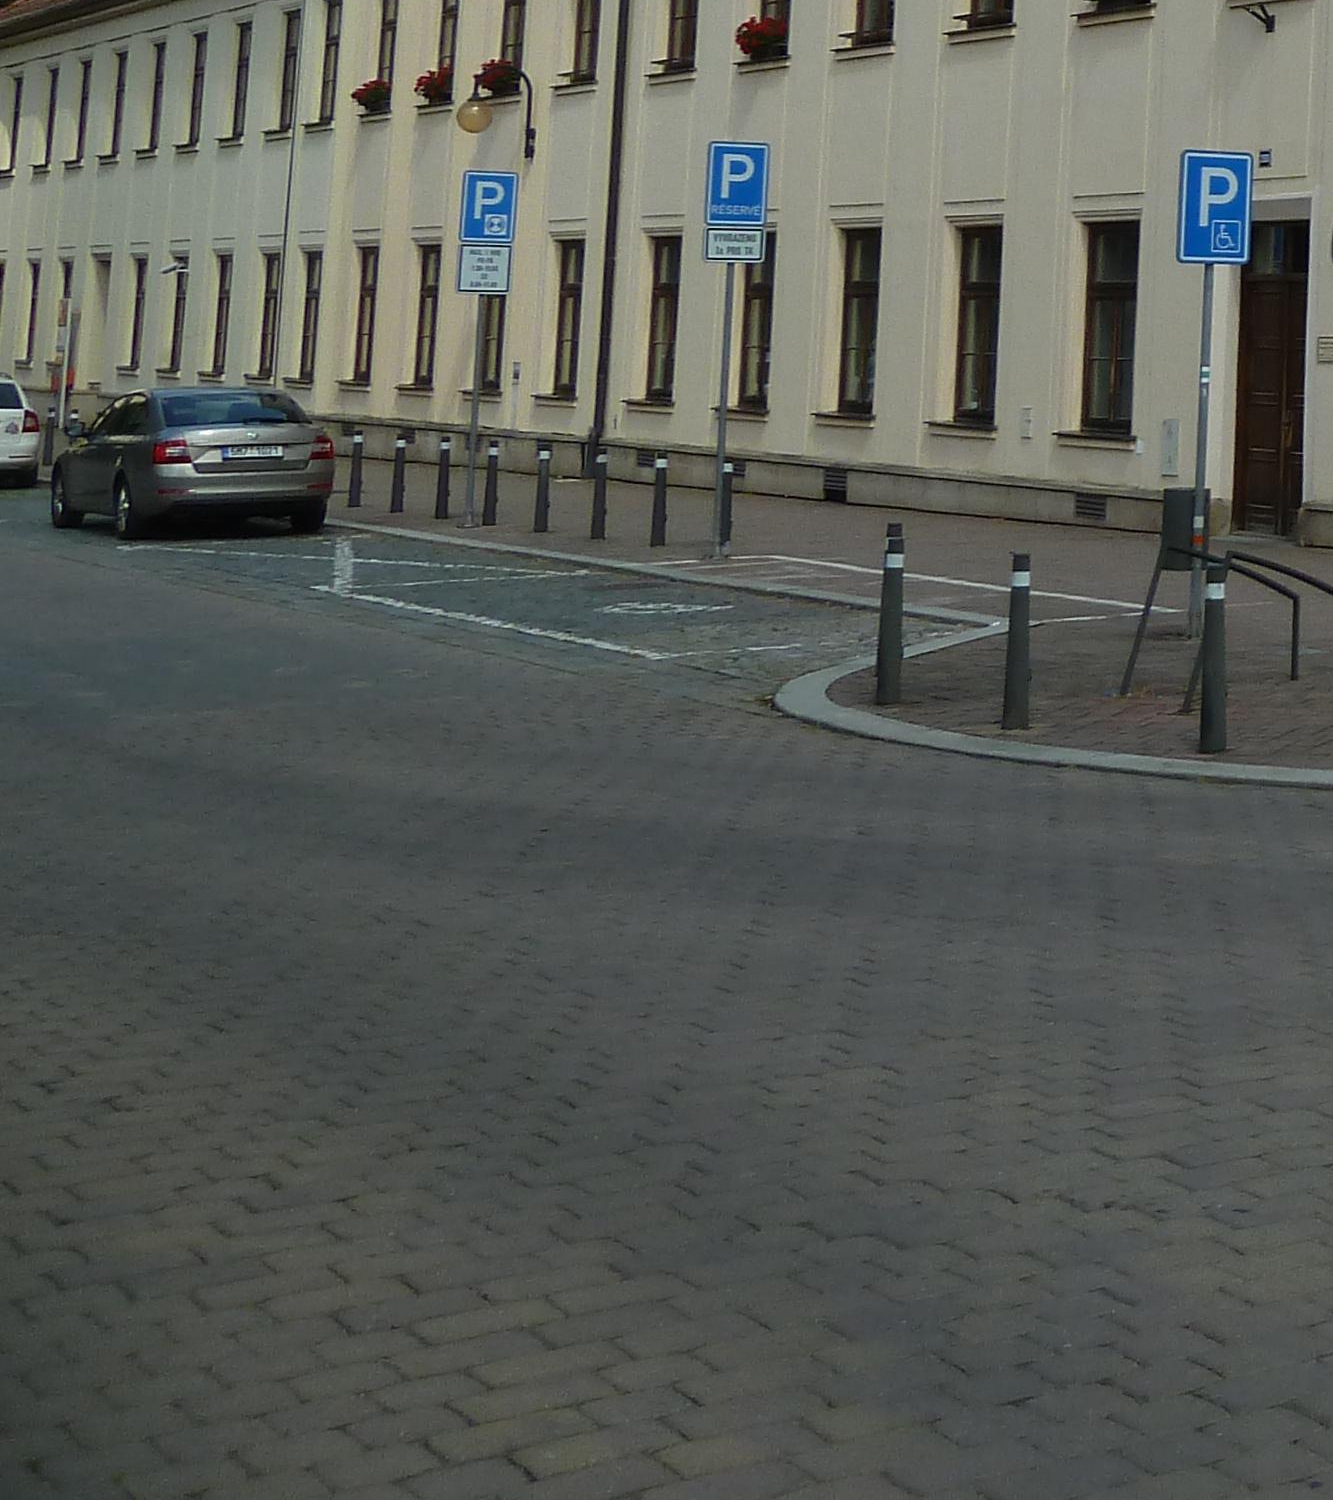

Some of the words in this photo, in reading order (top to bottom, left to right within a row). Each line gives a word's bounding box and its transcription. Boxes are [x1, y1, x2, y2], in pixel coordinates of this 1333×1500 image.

[720, 153, 755, 199] P
[1199, 167, 1238, 227] P
[473, 180, 505, 219] P
